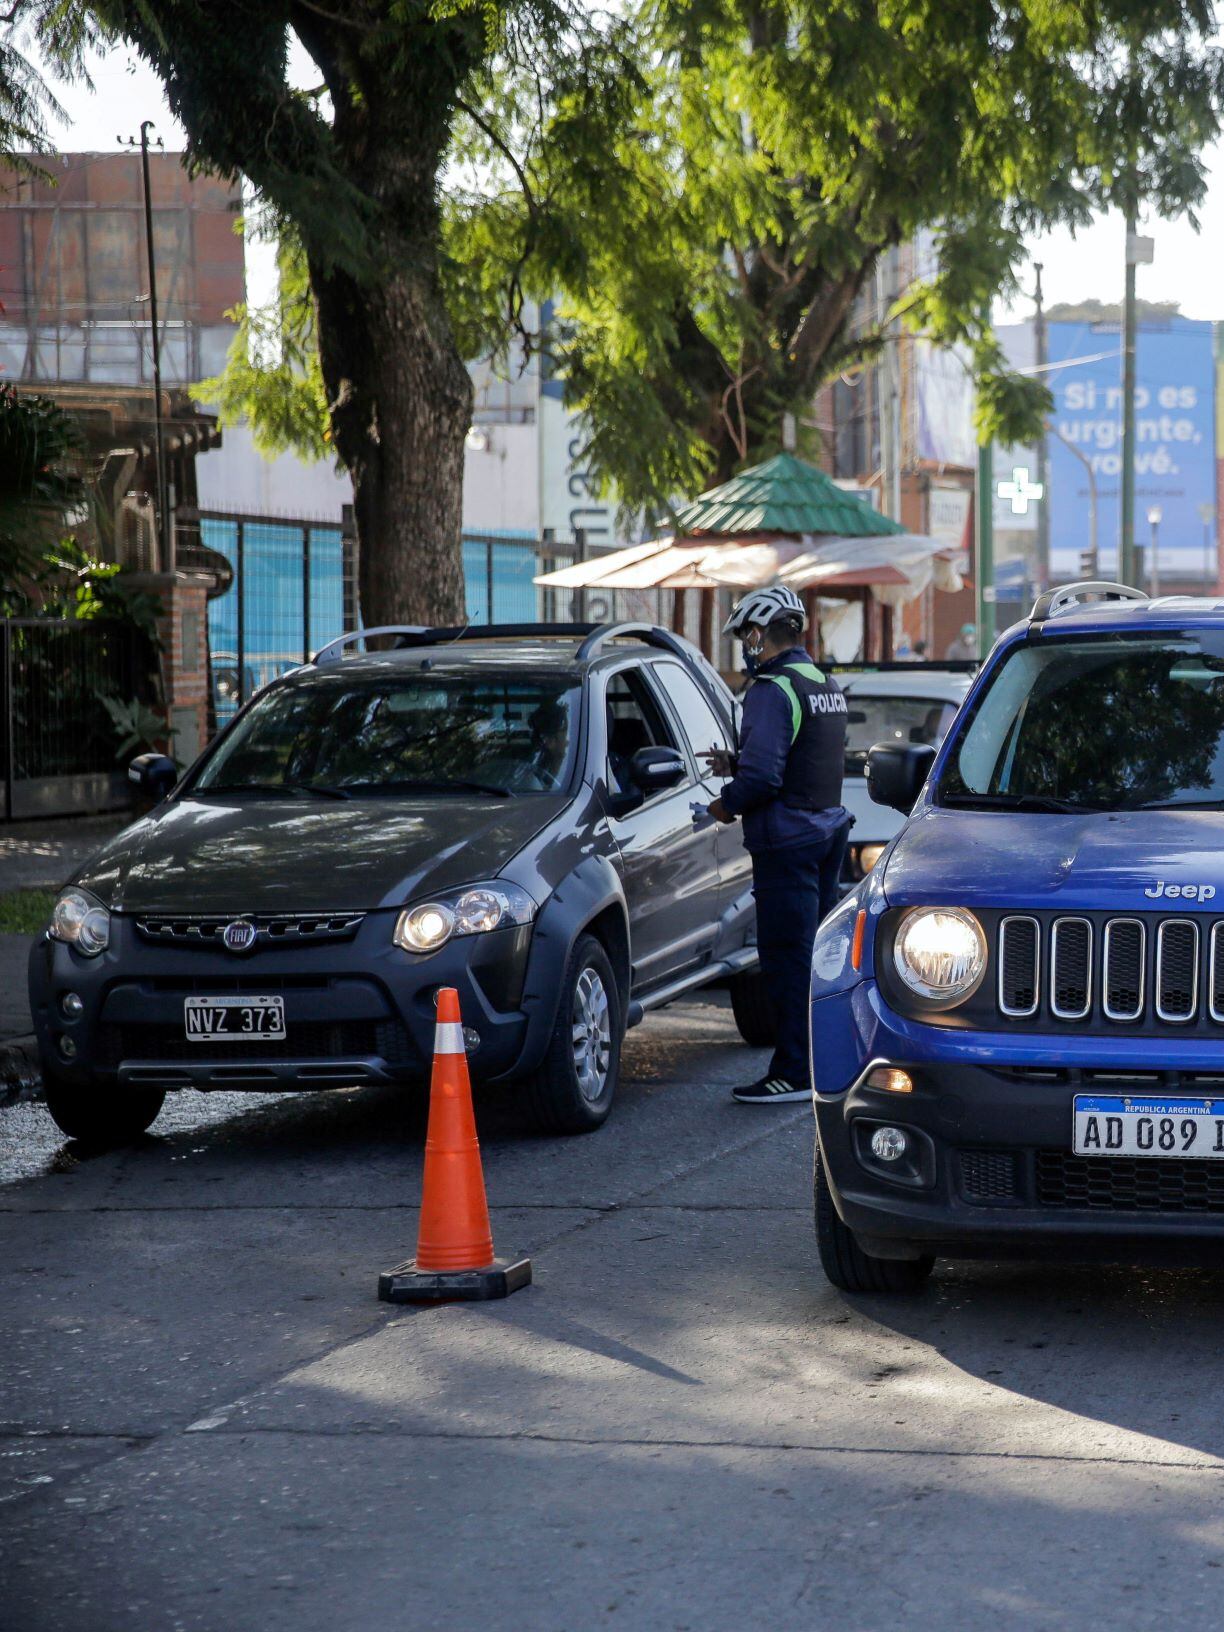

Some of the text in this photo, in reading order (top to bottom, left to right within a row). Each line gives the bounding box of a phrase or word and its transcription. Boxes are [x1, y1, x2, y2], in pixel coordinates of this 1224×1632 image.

[1064, 380, 1096, 410] Si
[1158, 386, 1197, 409] es
[1144, 881, 1216, 903] Jeep
[229, 928, 249, 943] FIAT
[188, 1008, 281, 1033] NVZ 373
[1167, 1106, 1211, 1115] ARGENTINA
[1083, 1116, 1123, 1149] AD
[1136, 1117, 1198, 1151] 089
